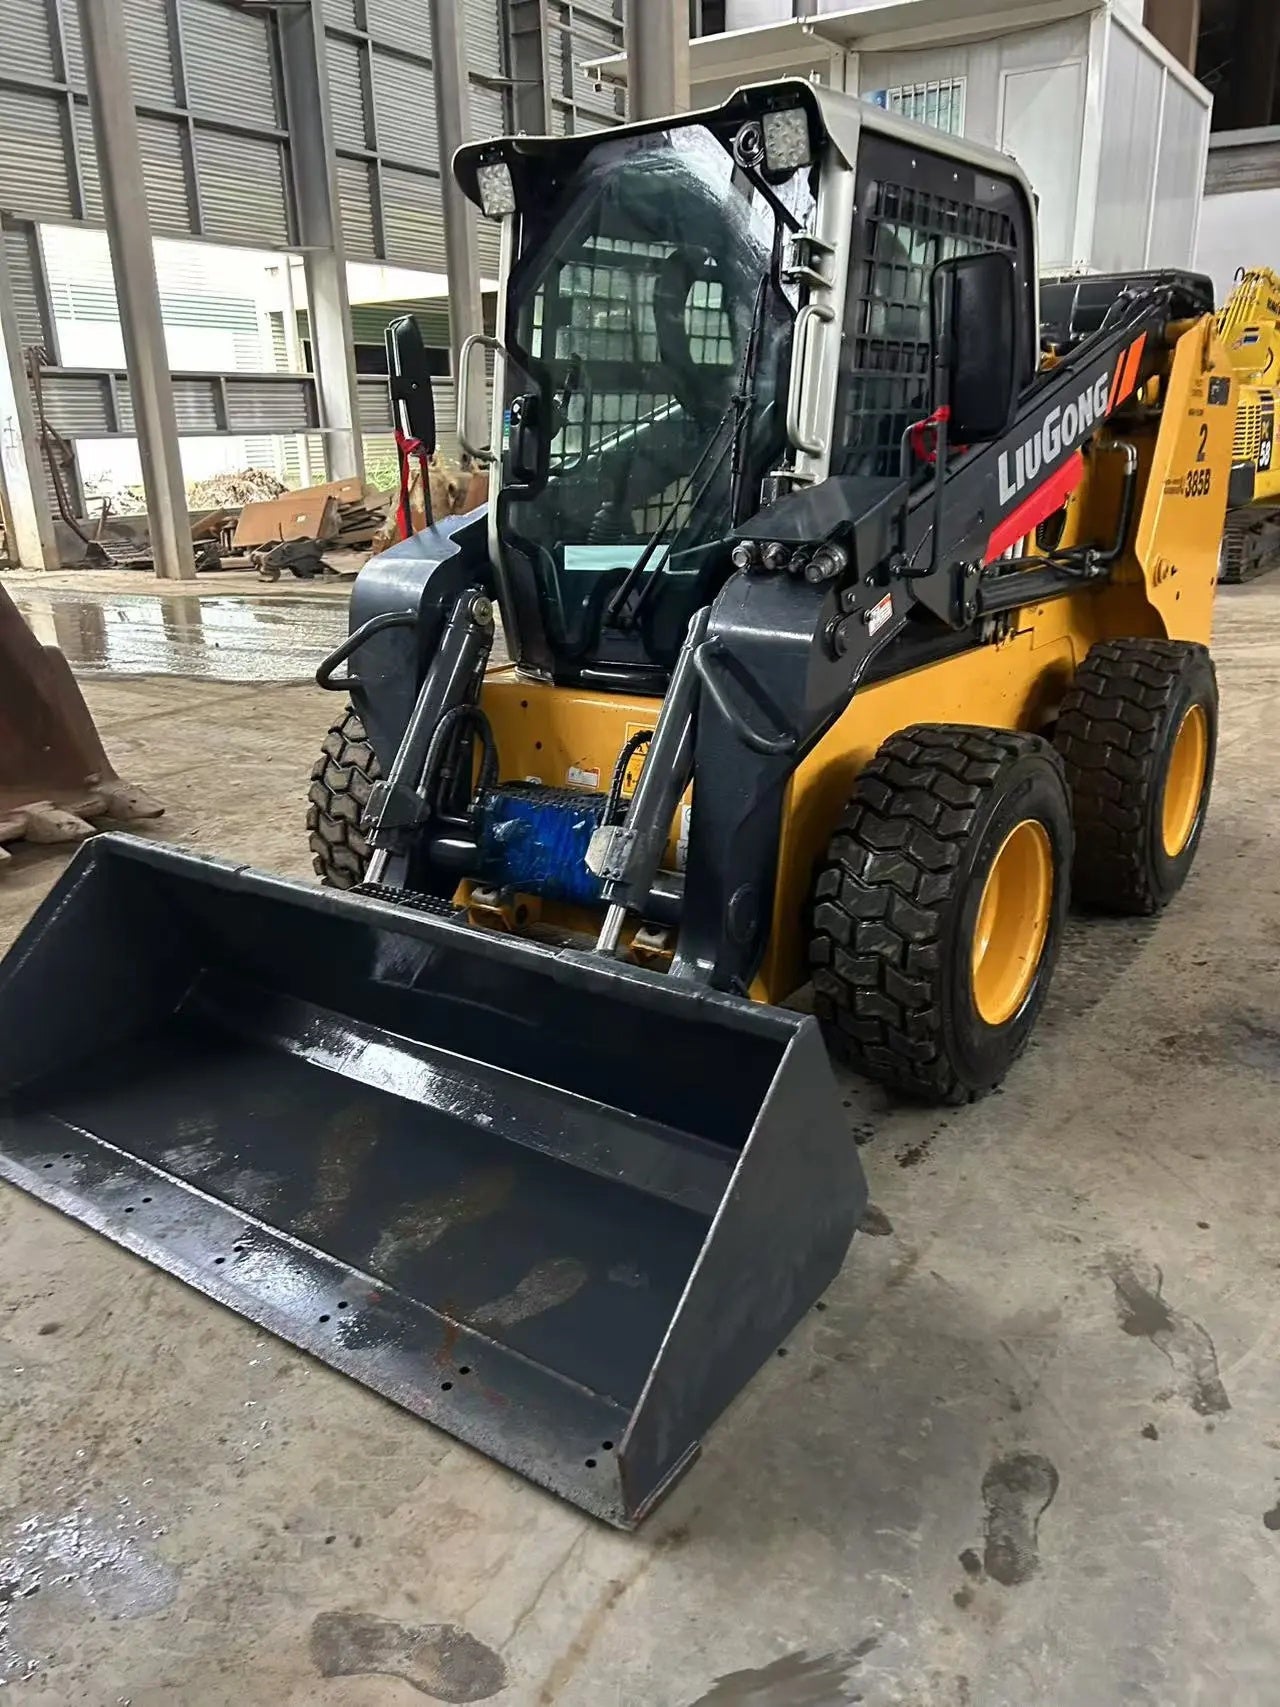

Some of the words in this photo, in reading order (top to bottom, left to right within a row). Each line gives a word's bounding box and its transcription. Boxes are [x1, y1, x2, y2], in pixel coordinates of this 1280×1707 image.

[998, 371, 1109, 506] LIUGONG
[1195, 423, 1208, 462] 2
[1184, 468, 1211, 498] 385B
